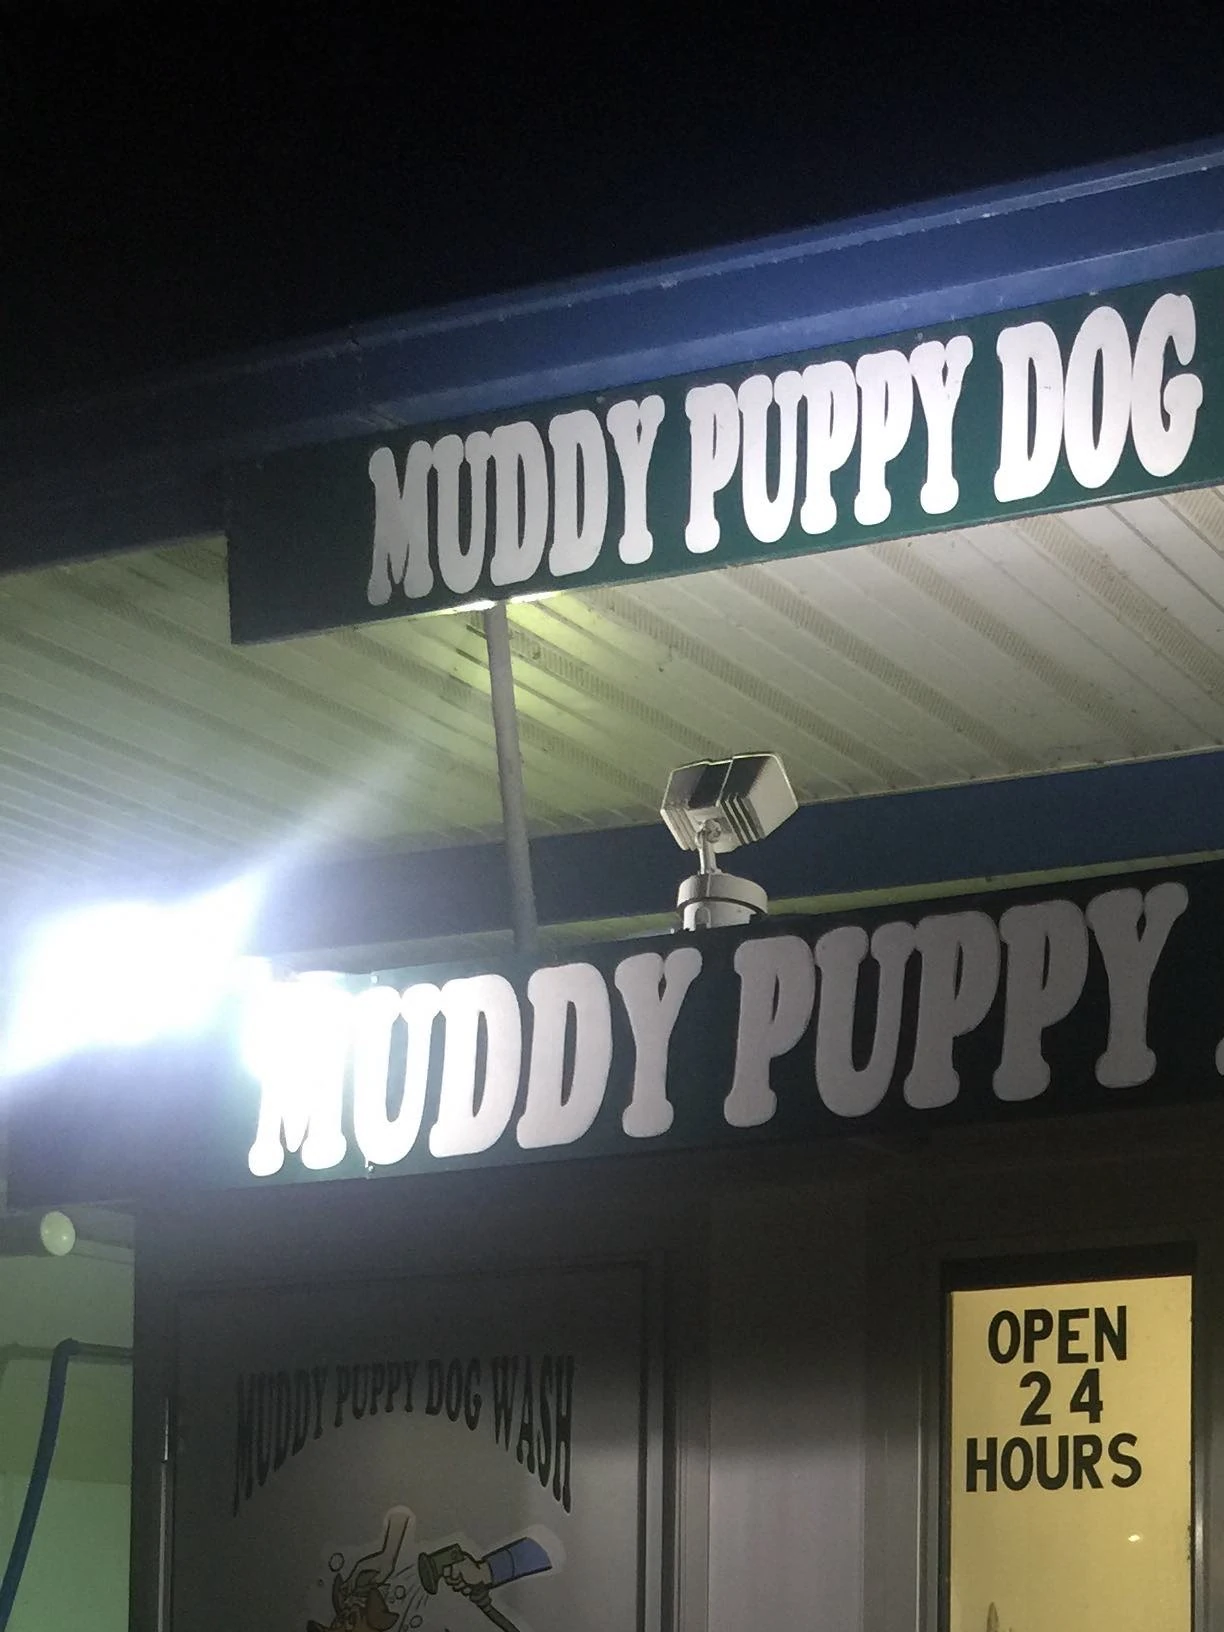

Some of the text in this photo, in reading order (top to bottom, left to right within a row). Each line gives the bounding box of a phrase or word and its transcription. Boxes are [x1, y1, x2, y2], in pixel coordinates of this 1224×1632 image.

[367, 394, 665, 606] MUDDY
[685, 335, 973, 554] PUPPY
[993, 292, 1204, 503] DOG
[245, 946, 703, 1178] MUDDY
[723, 881, 1190, 1129] PUPPY
[987, 1304, 1128, 1365] OPEN
[232, 1354, 575, 1518] MUDDY PUPPY DOG WASH
[965, 1432, 1143, 1493] HOURS
